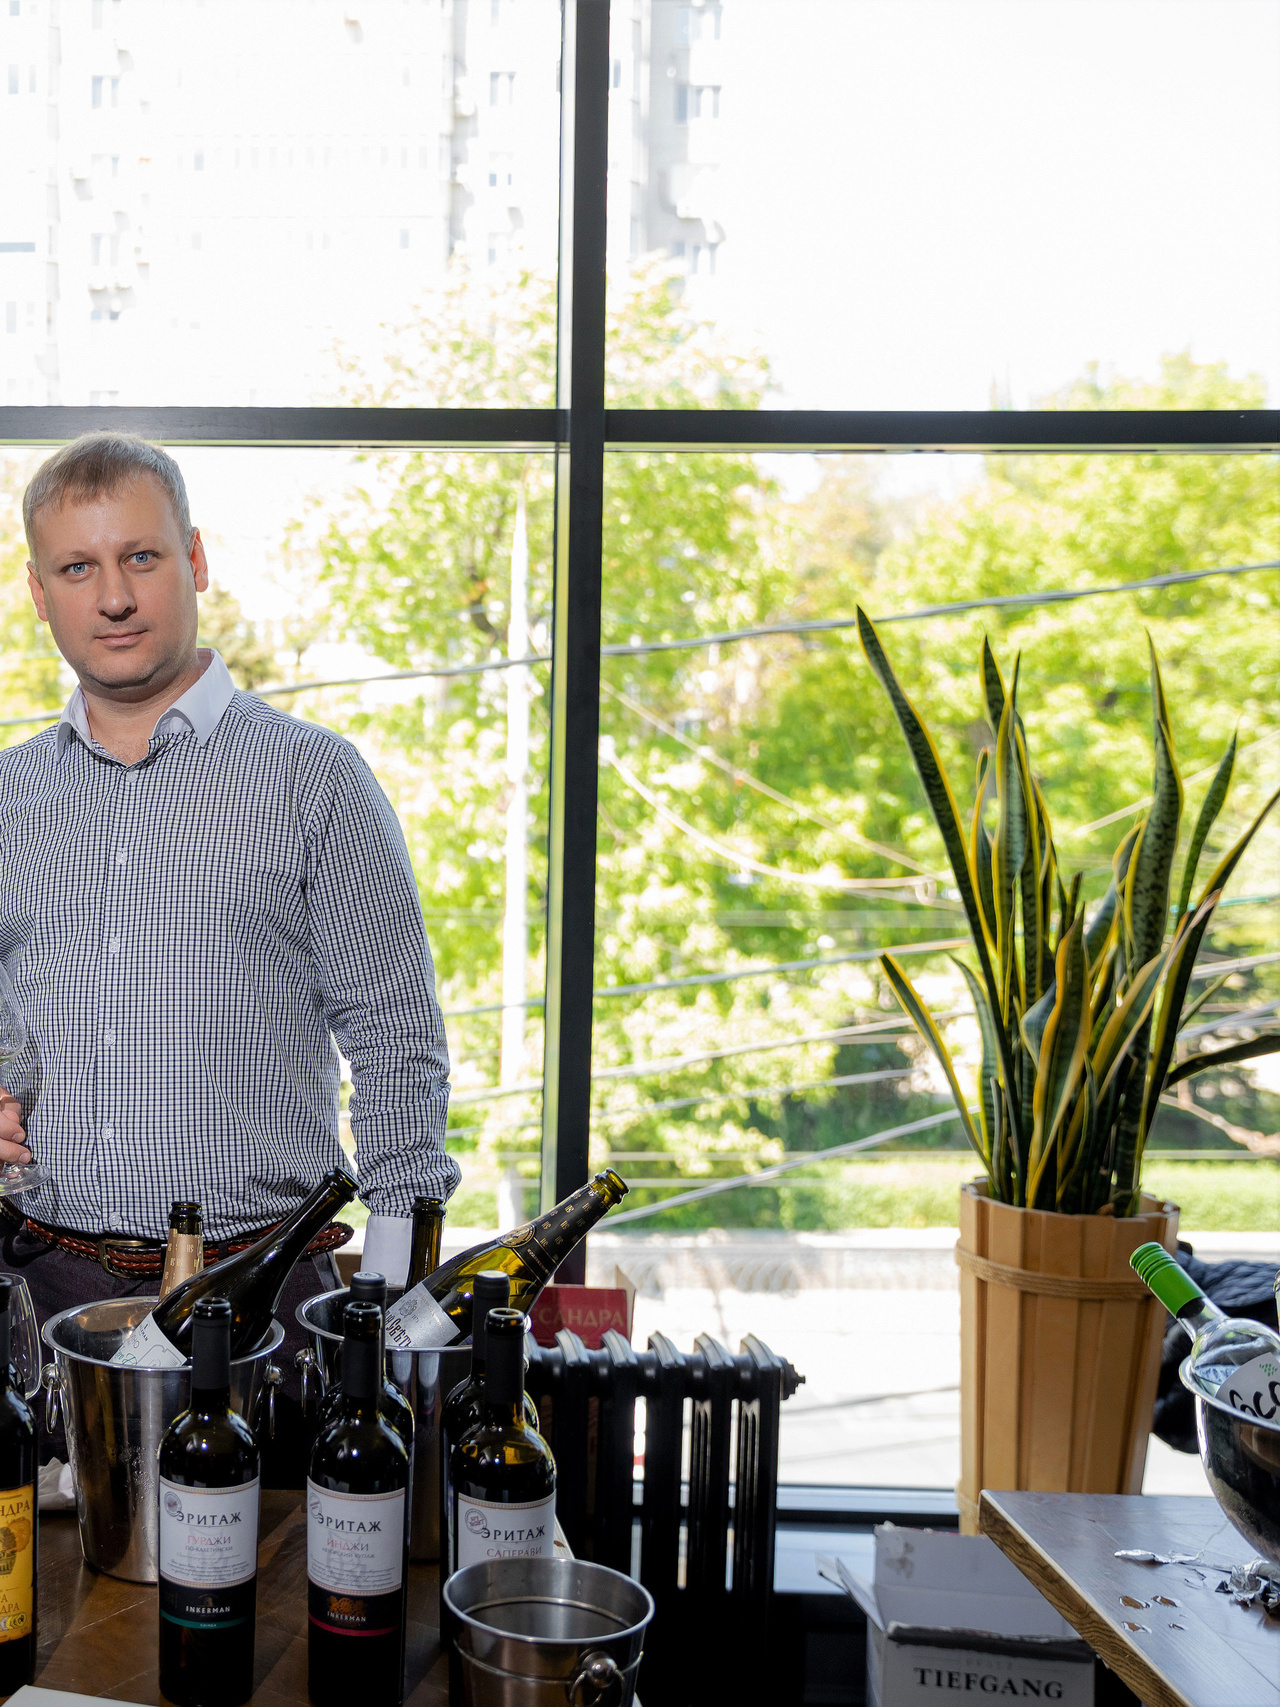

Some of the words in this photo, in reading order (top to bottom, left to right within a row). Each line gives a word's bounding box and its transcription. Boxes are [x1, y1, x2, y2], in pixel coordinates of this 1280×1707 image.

[531, 1306, 625, 1328] САНДРА
[175, 1510, 242, 1526] ЭРИТАЖ
[317, 1512, 382, 1533] ЭРИТАЖ
[480, 1524, 546, 1541] ЭРИТАЖ
[186, 1535, 232, 1546] ГУРДЖИ
[326, 1538, 369, 1552] ИНДЖИ
[485, 1546, 543, 1558] САПЕРАВИ
[185, 1605, 231, 1614] INKERMAN
[326, 1611, 366, 1622] INKERMAN
[912, 1666, 1064, 1699] TIEFGANG
